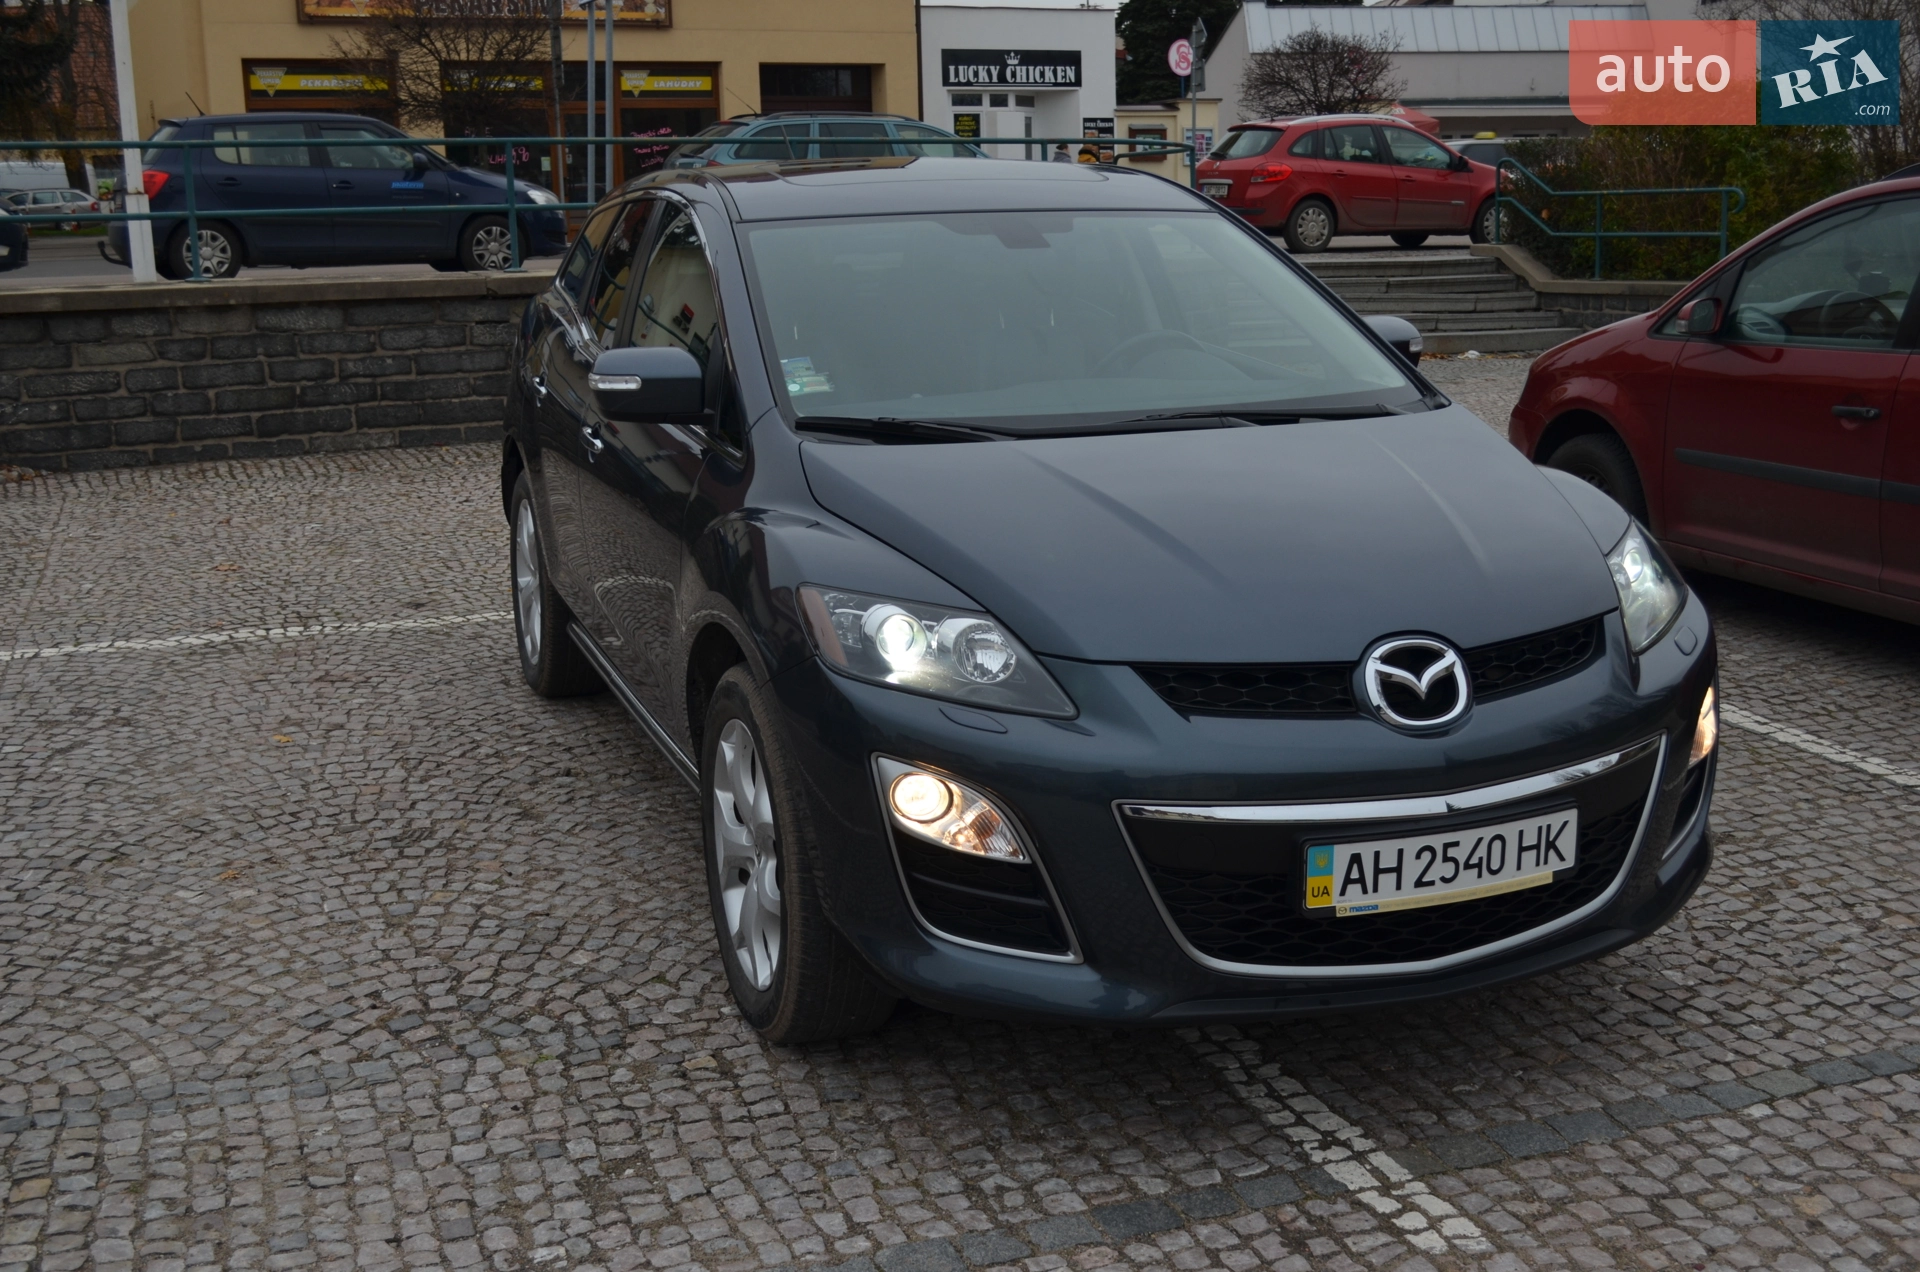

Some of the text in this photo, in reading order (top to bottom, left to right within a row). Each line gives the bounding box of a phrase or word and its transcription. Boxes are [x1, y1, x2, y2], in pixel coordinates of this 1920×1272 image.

[948, 65, 1076, 83] LUCKY CHICKEN
[1311, 820, 1570, 898] UA AH 2540 HK
